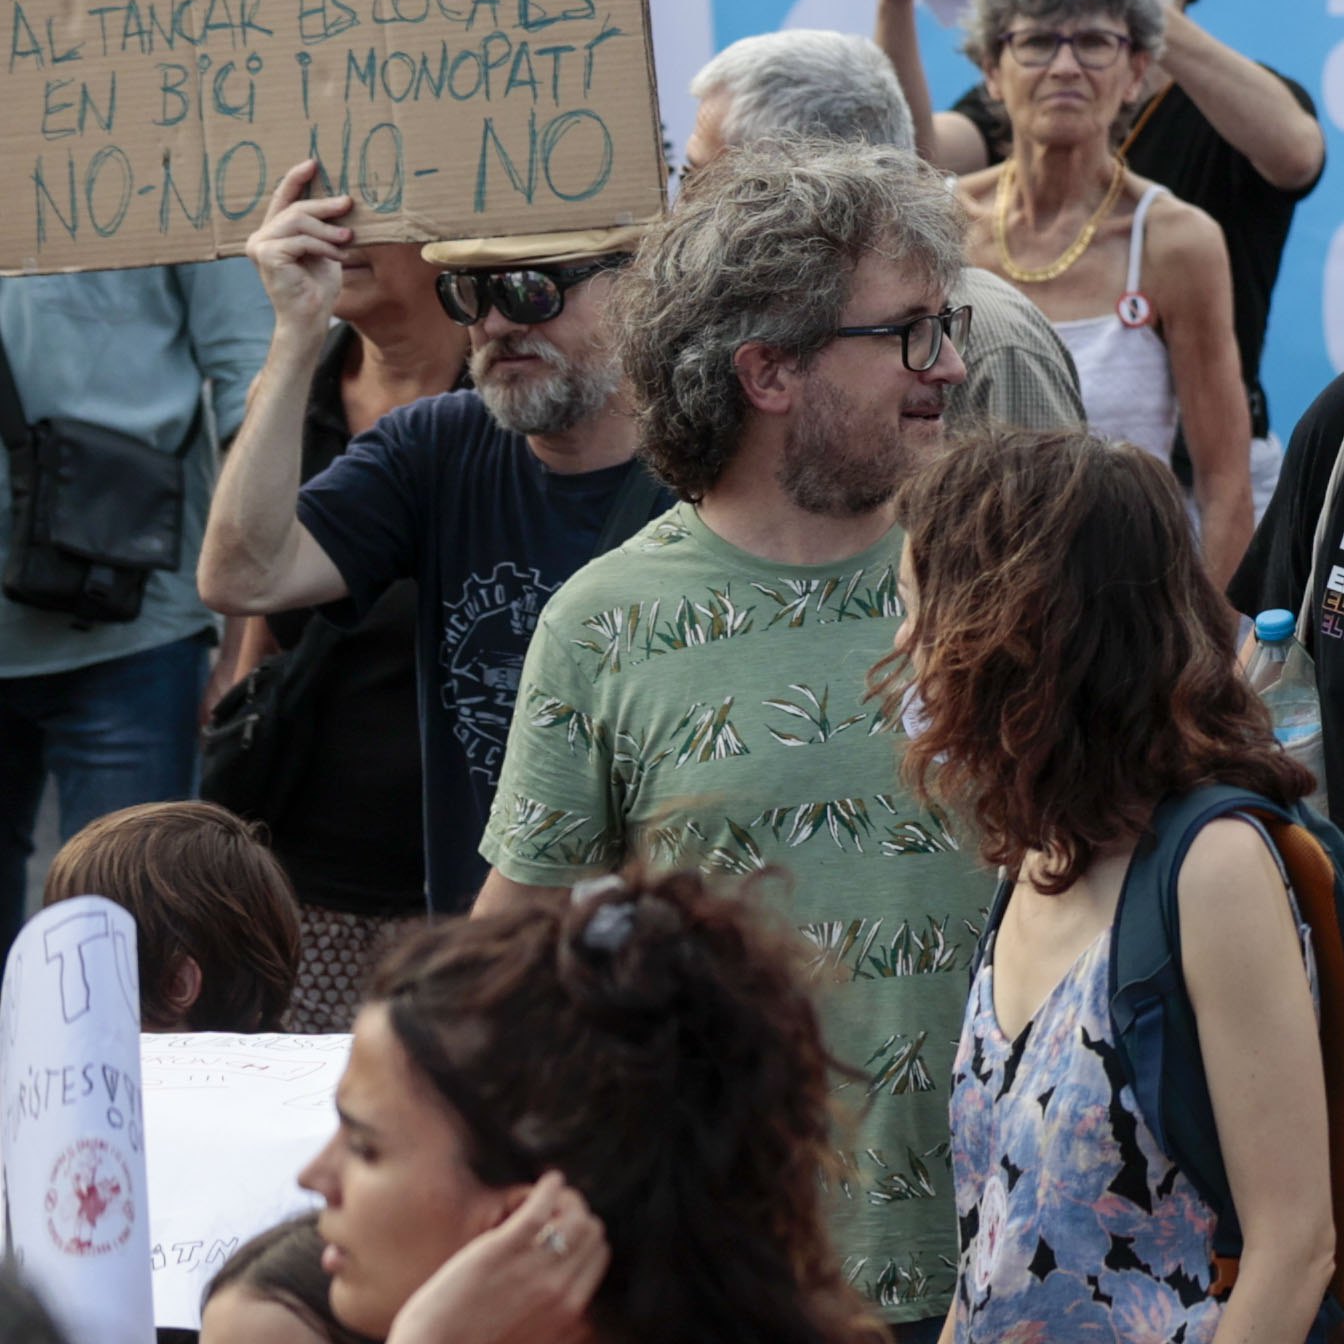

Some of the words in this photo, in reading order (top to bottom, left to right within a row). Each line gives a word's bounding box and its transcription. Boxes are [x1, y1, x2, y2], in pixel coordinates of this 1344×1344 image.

[9, 1, 87, 72] AL
[41, 70, 117, 140] EN
[1320, 613, 1344, 639] EL
